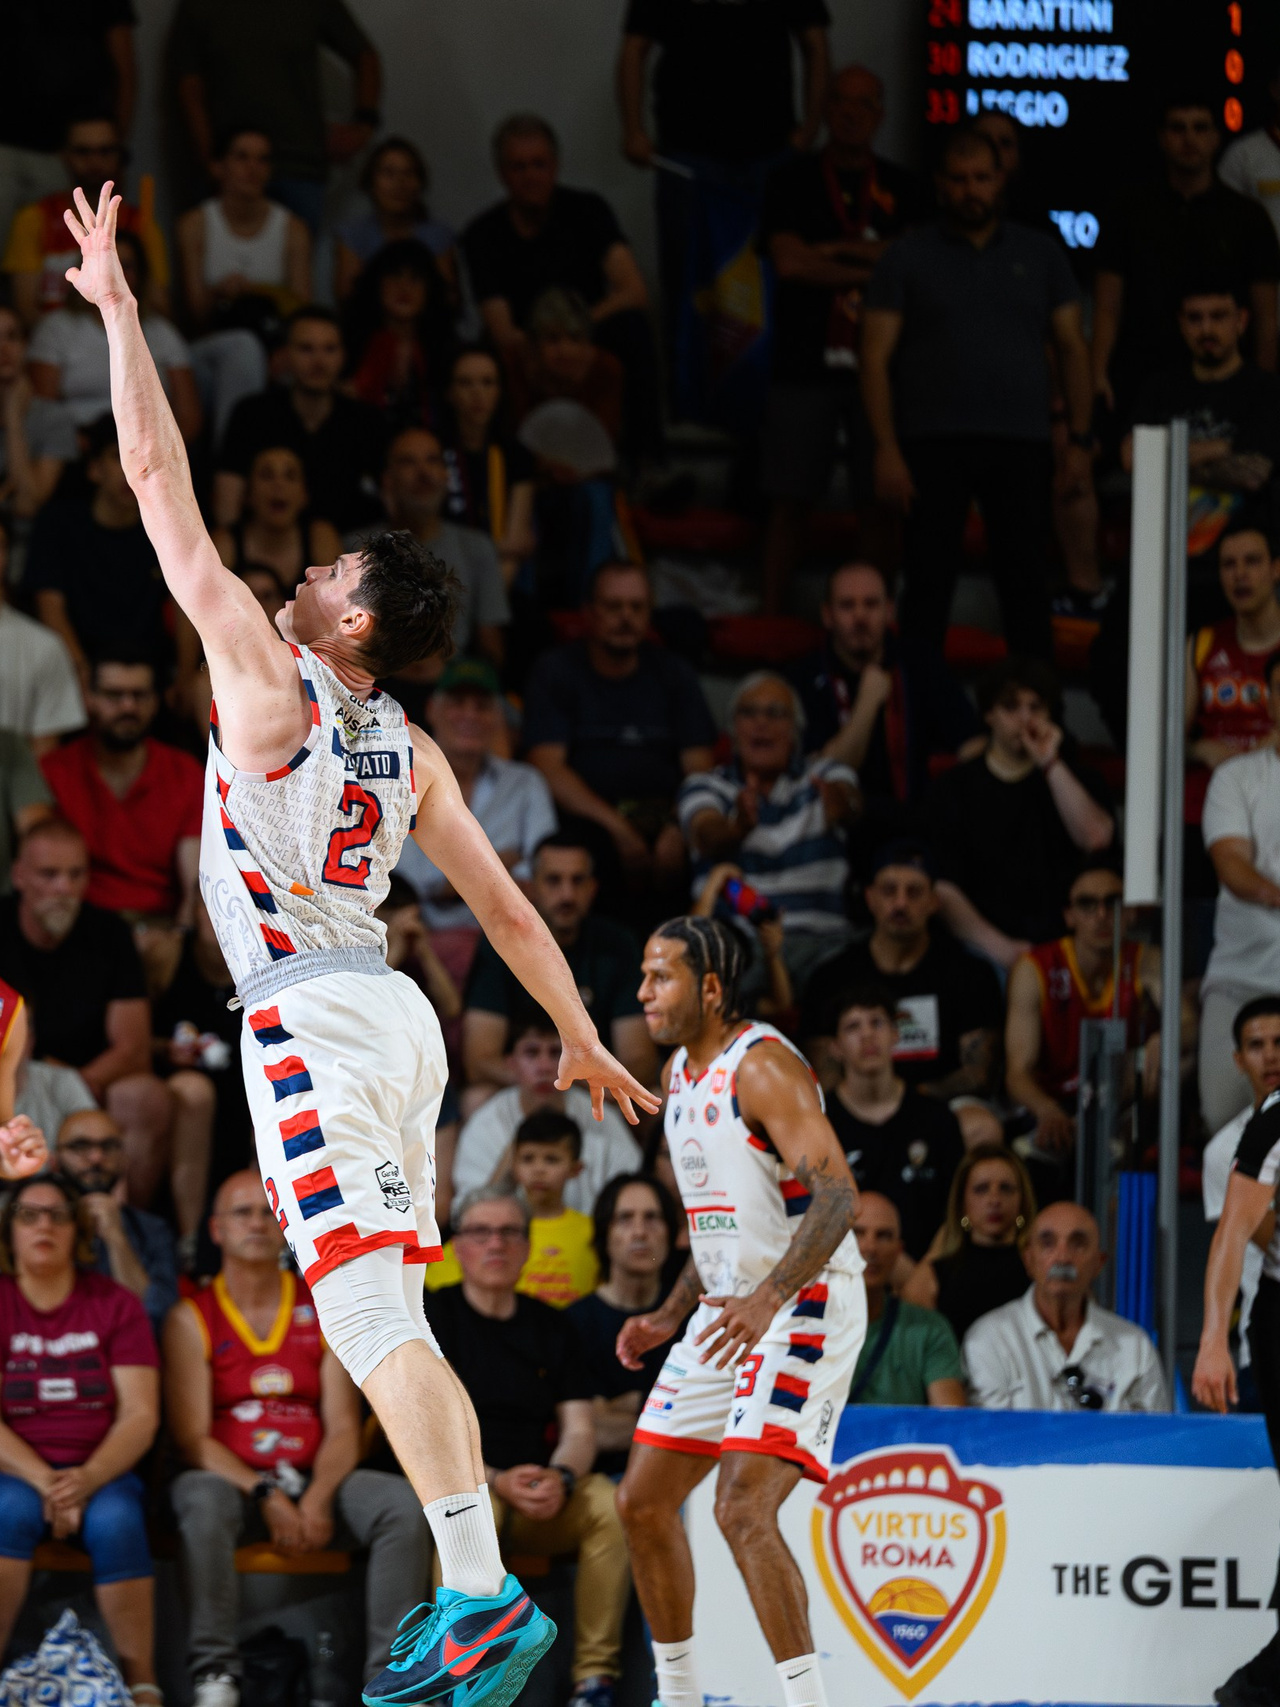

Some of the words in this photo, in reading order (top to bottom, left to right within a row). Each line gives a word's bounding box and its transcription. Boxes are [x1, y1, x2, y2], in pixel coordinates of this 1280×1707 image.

[968, 0, 1114, 32] BARATTINI
[1227, 1, 1242, 37] 1
[967, 41, 1130, 81] RODRIGUEZ
[1224, 48, 1244, 84] 0
[1223, 97, 1244, 132] 0
[266, 798, 304, 821] PESCIA
[266, 815, 319, 840] UZZANESE
[267, 829, 321, 856] LARCIANO
[322, 780, 384, 890] 2
[852, 1510, 968, 1541] VIRTUS
[860, 1543, 956, 1569] ROMA
[1051, 1563, 1111, 1597] THE
[892, 1623, 928, 1641] 1960
